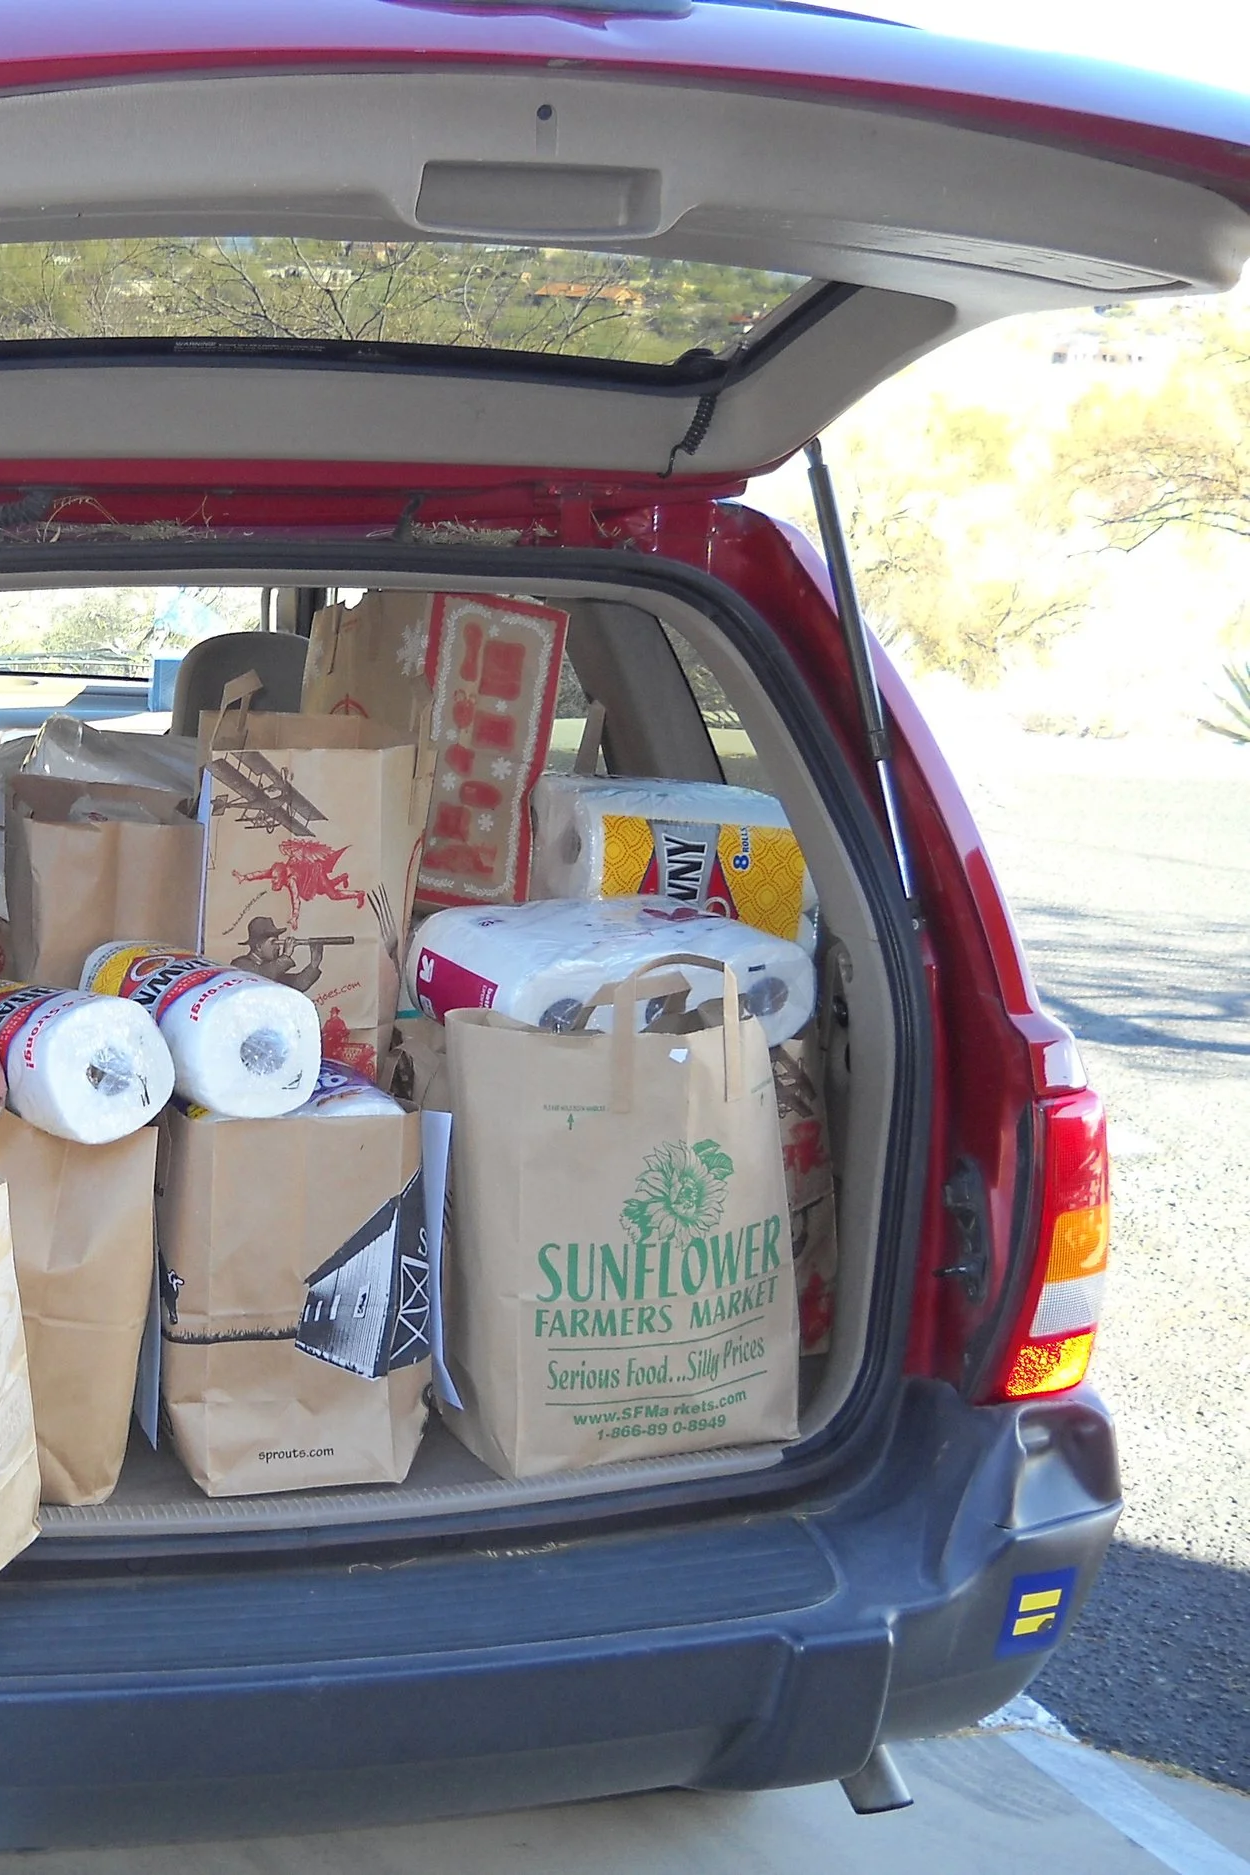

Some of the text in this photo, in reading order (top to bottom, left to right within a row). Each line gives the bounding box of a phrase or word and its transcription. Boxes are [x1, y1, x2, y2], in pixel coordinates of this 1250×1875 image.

[732, 854, 750, 870] 8
[536, 1213, 782, 1303] SUNFLOWER
[534, 1274, 779, 1338] FARMERS MARKET
[546, 1360, 621, 1391] Serious
[722, 1335, 765, 1370] Prices
[258, 1446, 335, 1464] sprouts.com
